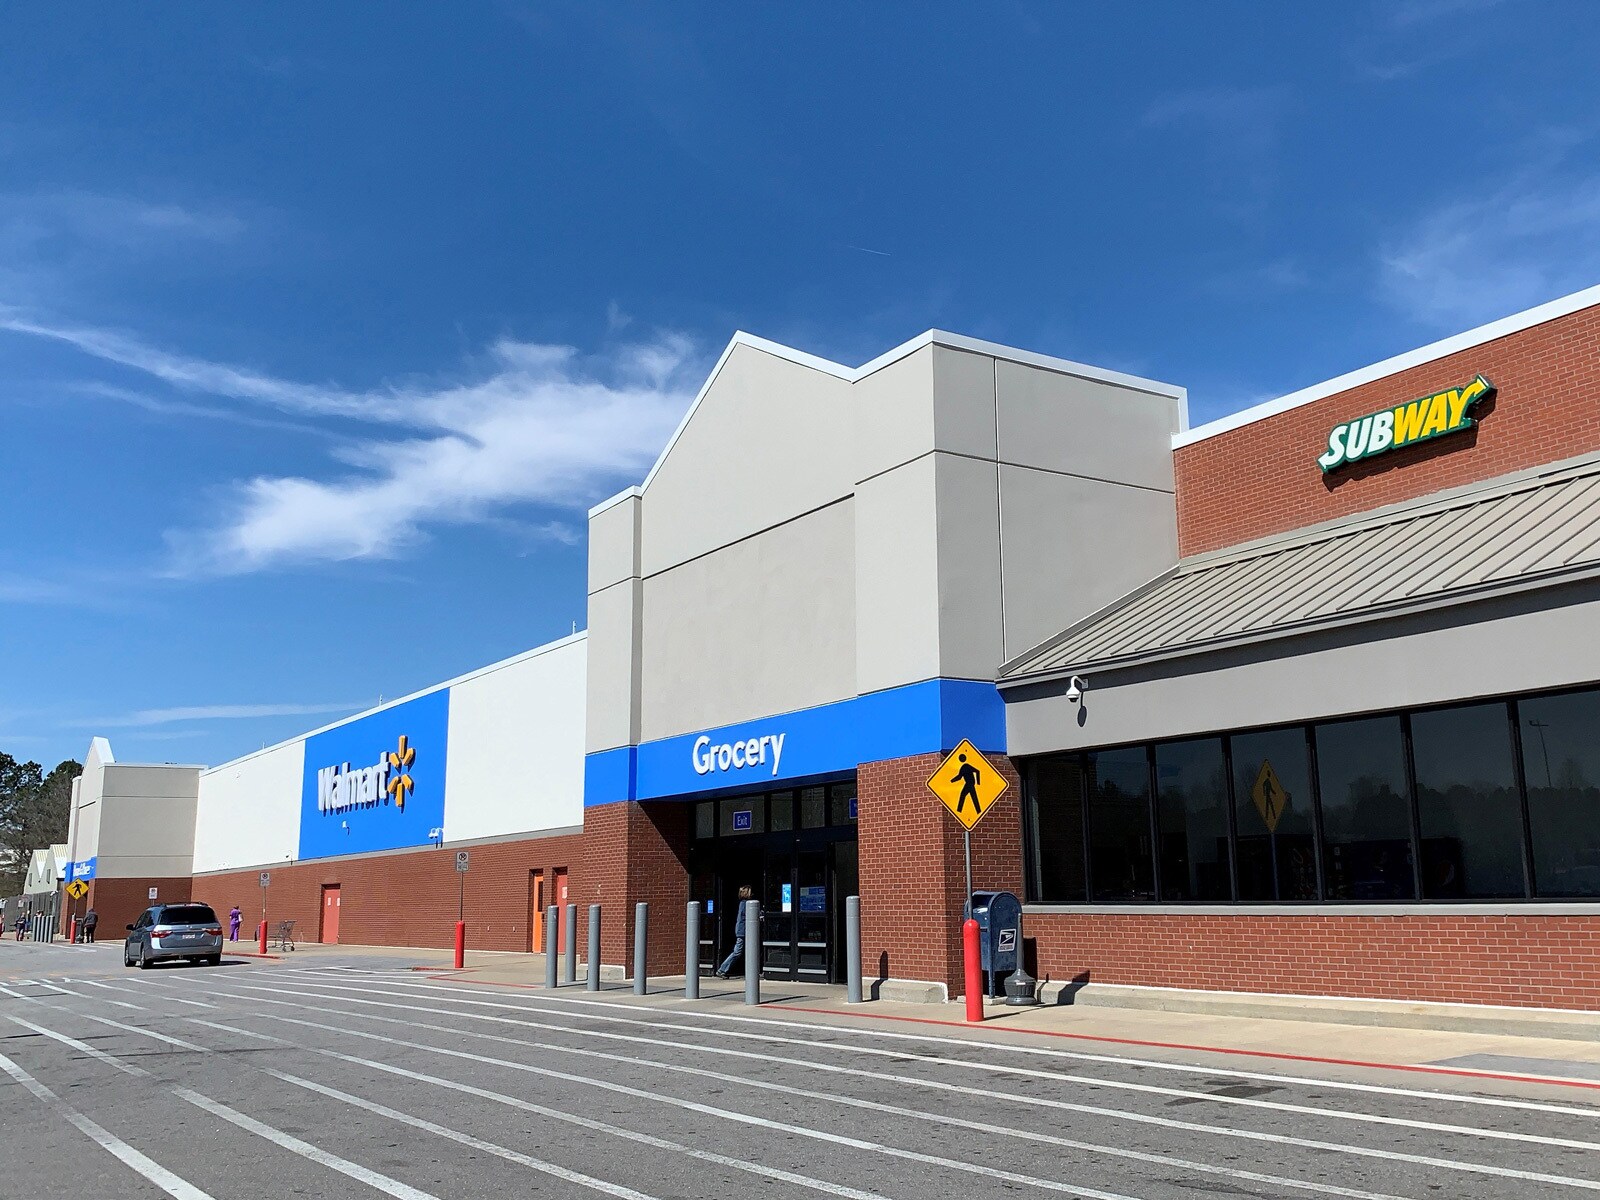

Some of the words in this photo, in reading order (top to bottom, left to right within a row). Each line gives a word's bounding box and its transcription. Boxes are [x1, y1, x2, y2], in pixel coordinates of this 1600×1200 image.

[1317, 373, 1490, 470] SUBWAY
[692, 733, 786, 776] Grocery
[317, 751, 389, 811] Walmart
[737, 815, 748, 826] Exit
